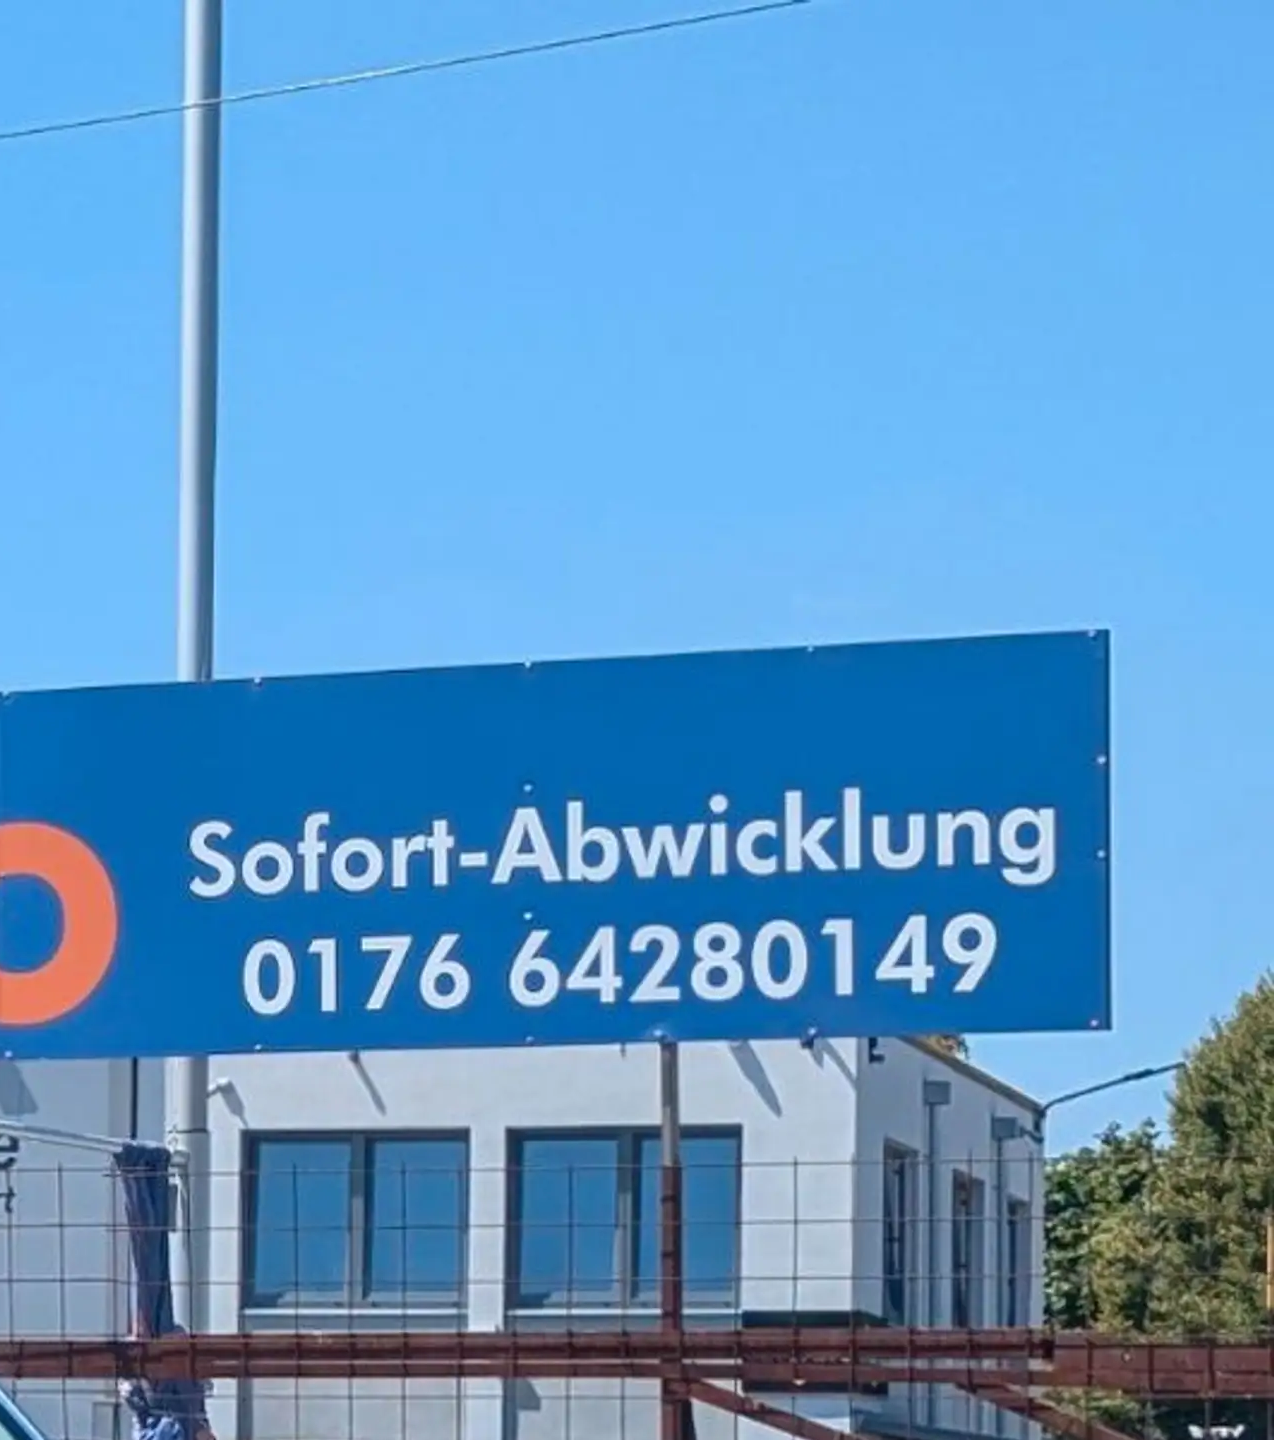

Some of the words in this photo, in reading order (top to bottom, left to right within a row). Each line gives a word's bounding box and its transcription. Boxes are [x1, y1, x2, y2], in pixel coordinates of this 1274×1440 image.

[188, 787, 1057, 898] Sofort-Abwicklung
[242, 933, 471, 1016] 0176
[508, 912, 998, 1004] 64280149
